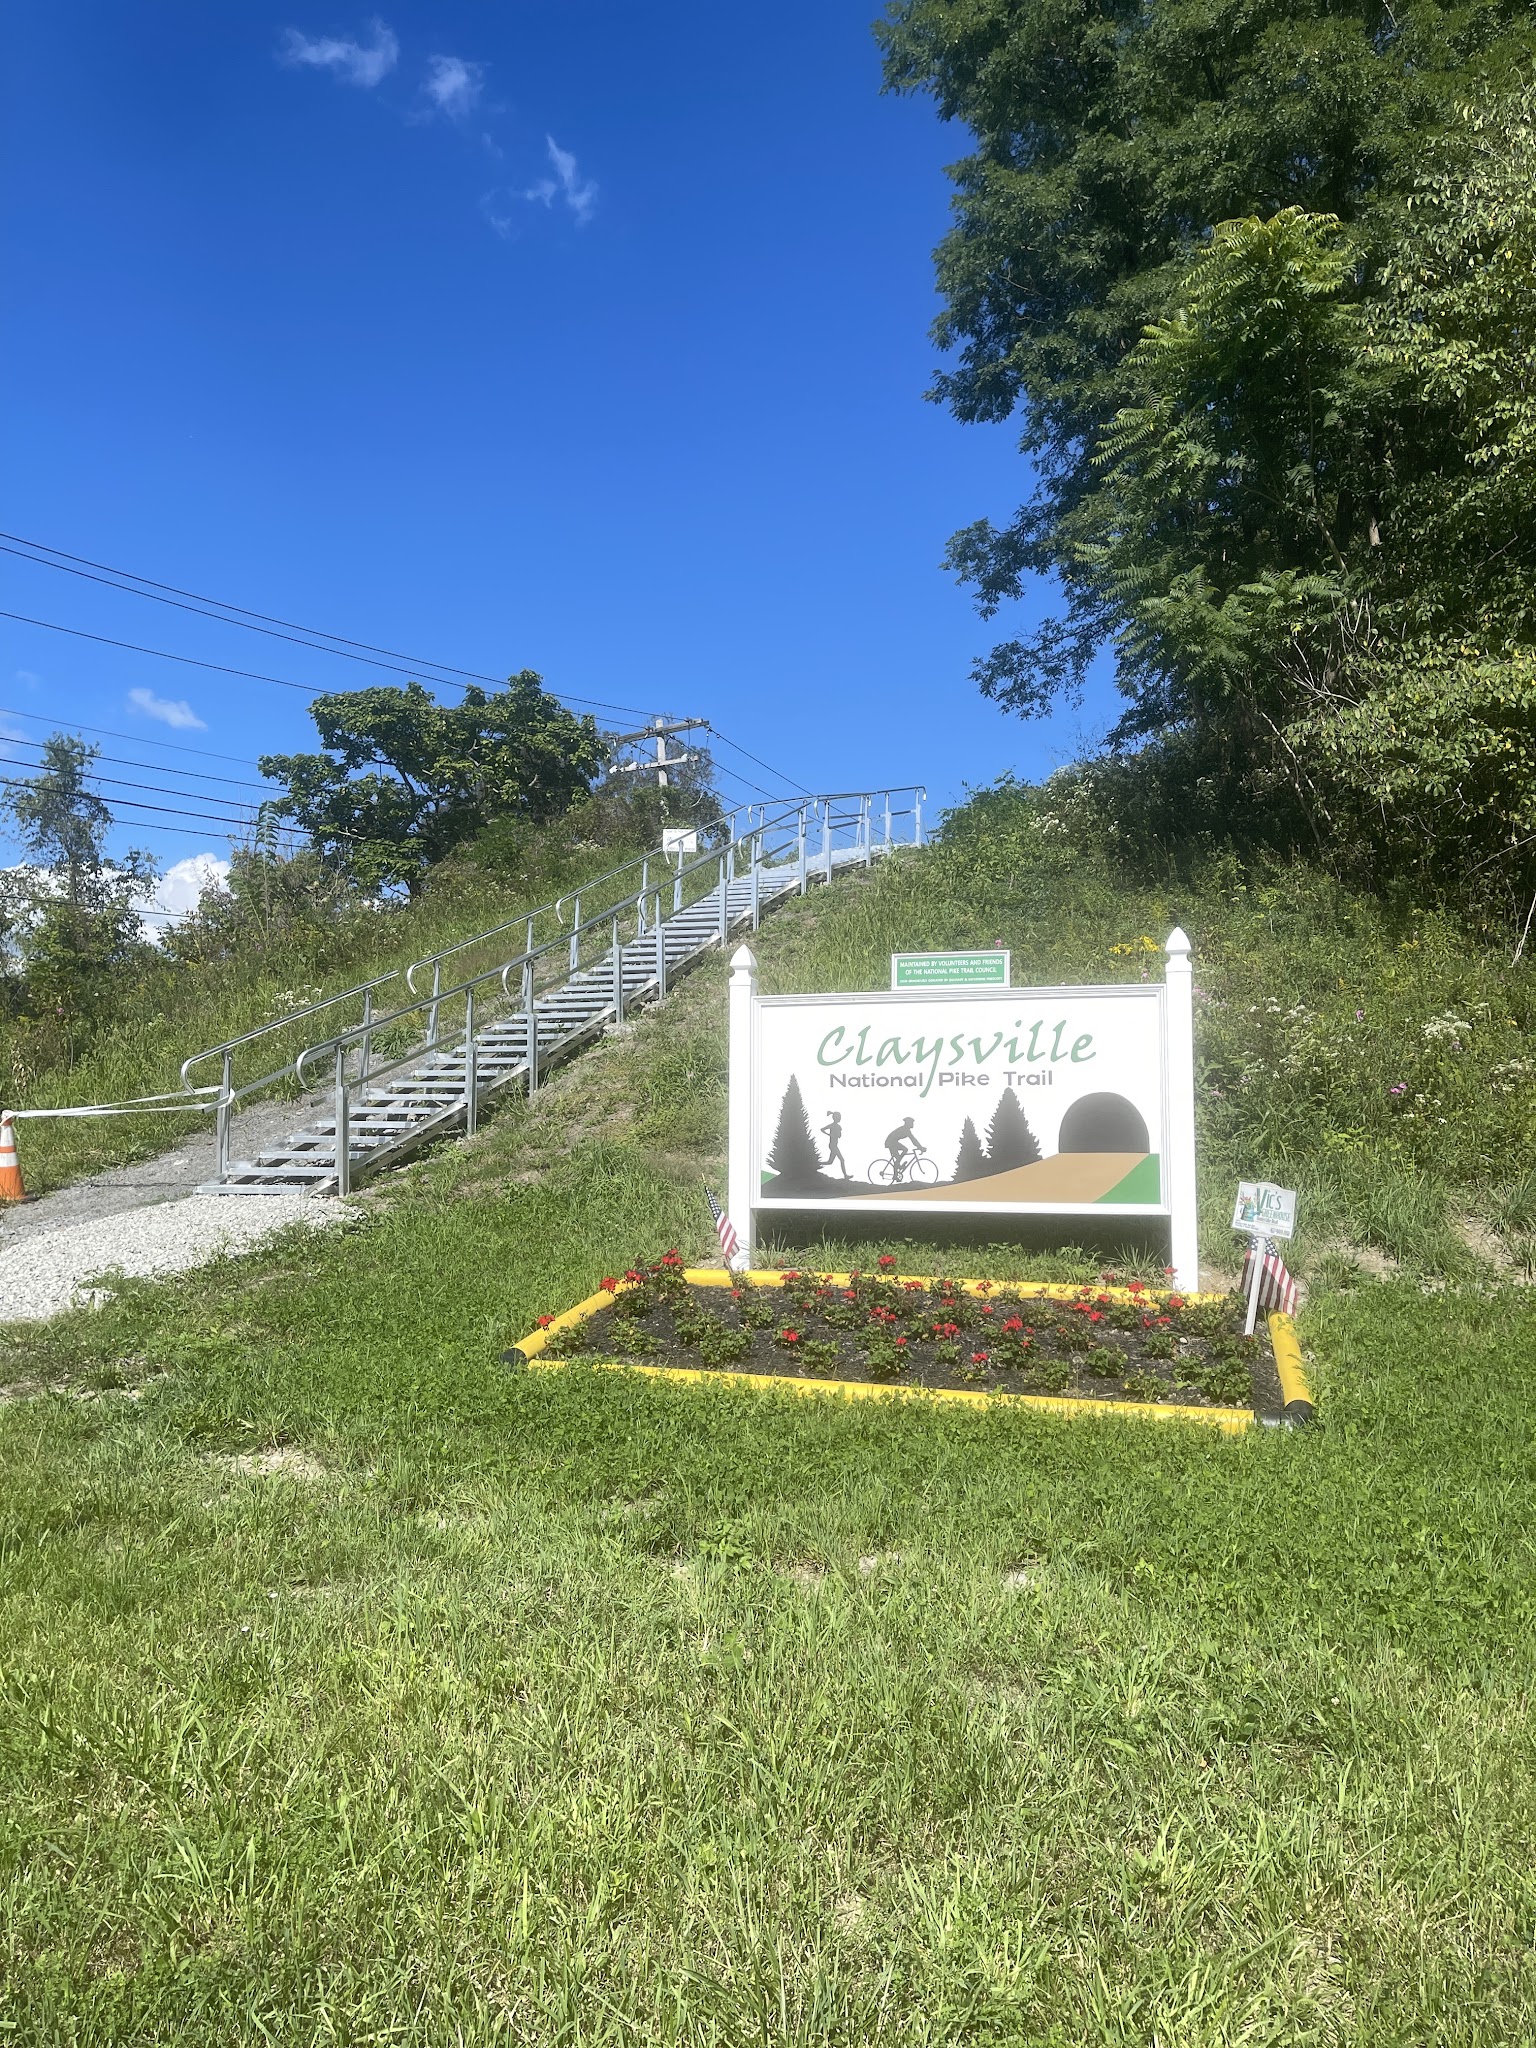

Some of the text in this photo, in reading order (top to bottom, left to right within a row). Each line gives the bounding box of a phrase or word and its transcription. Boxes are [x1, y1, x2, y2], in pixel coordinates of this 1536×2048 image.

[938, 959, 969, 967] VOLUNTEERS
[816, 1019, 1097, 1098] Claysville
[829, 1070, 1053, 1088] National Pike Trail
[1261, 1208, 1291, 1223] GREENHOUSE
